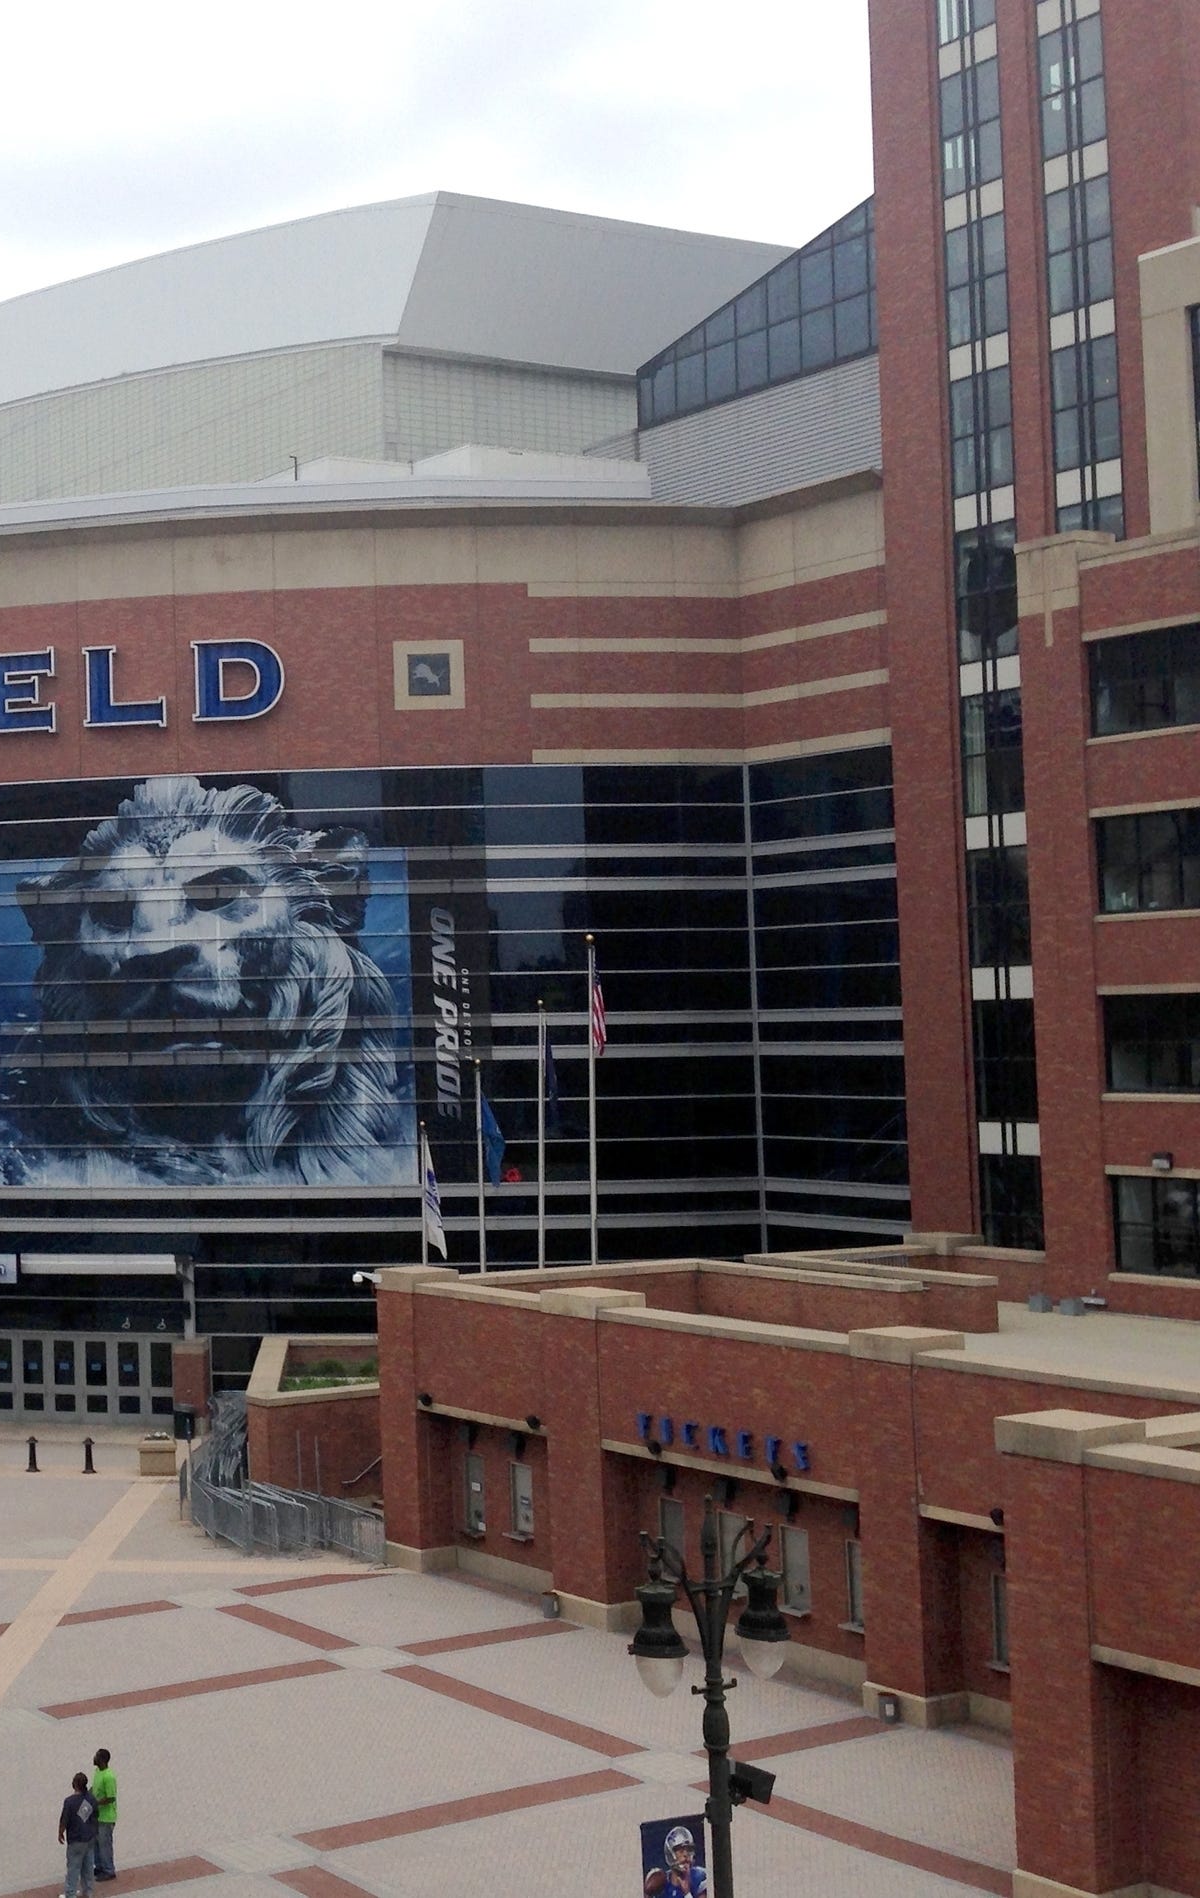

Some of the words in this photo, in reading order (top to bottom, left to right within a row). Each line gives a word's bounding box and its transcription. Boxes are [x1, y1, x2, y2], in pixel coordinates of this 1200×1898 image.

[431, 907, 457, 990] ONE
[461, 968, 470, 994] ONE
[434, 993, 462, 1121] PRIDE
[462, 1002, 472, 1060] DETROT
[637, 1412, 811, 1471] TICKETS
